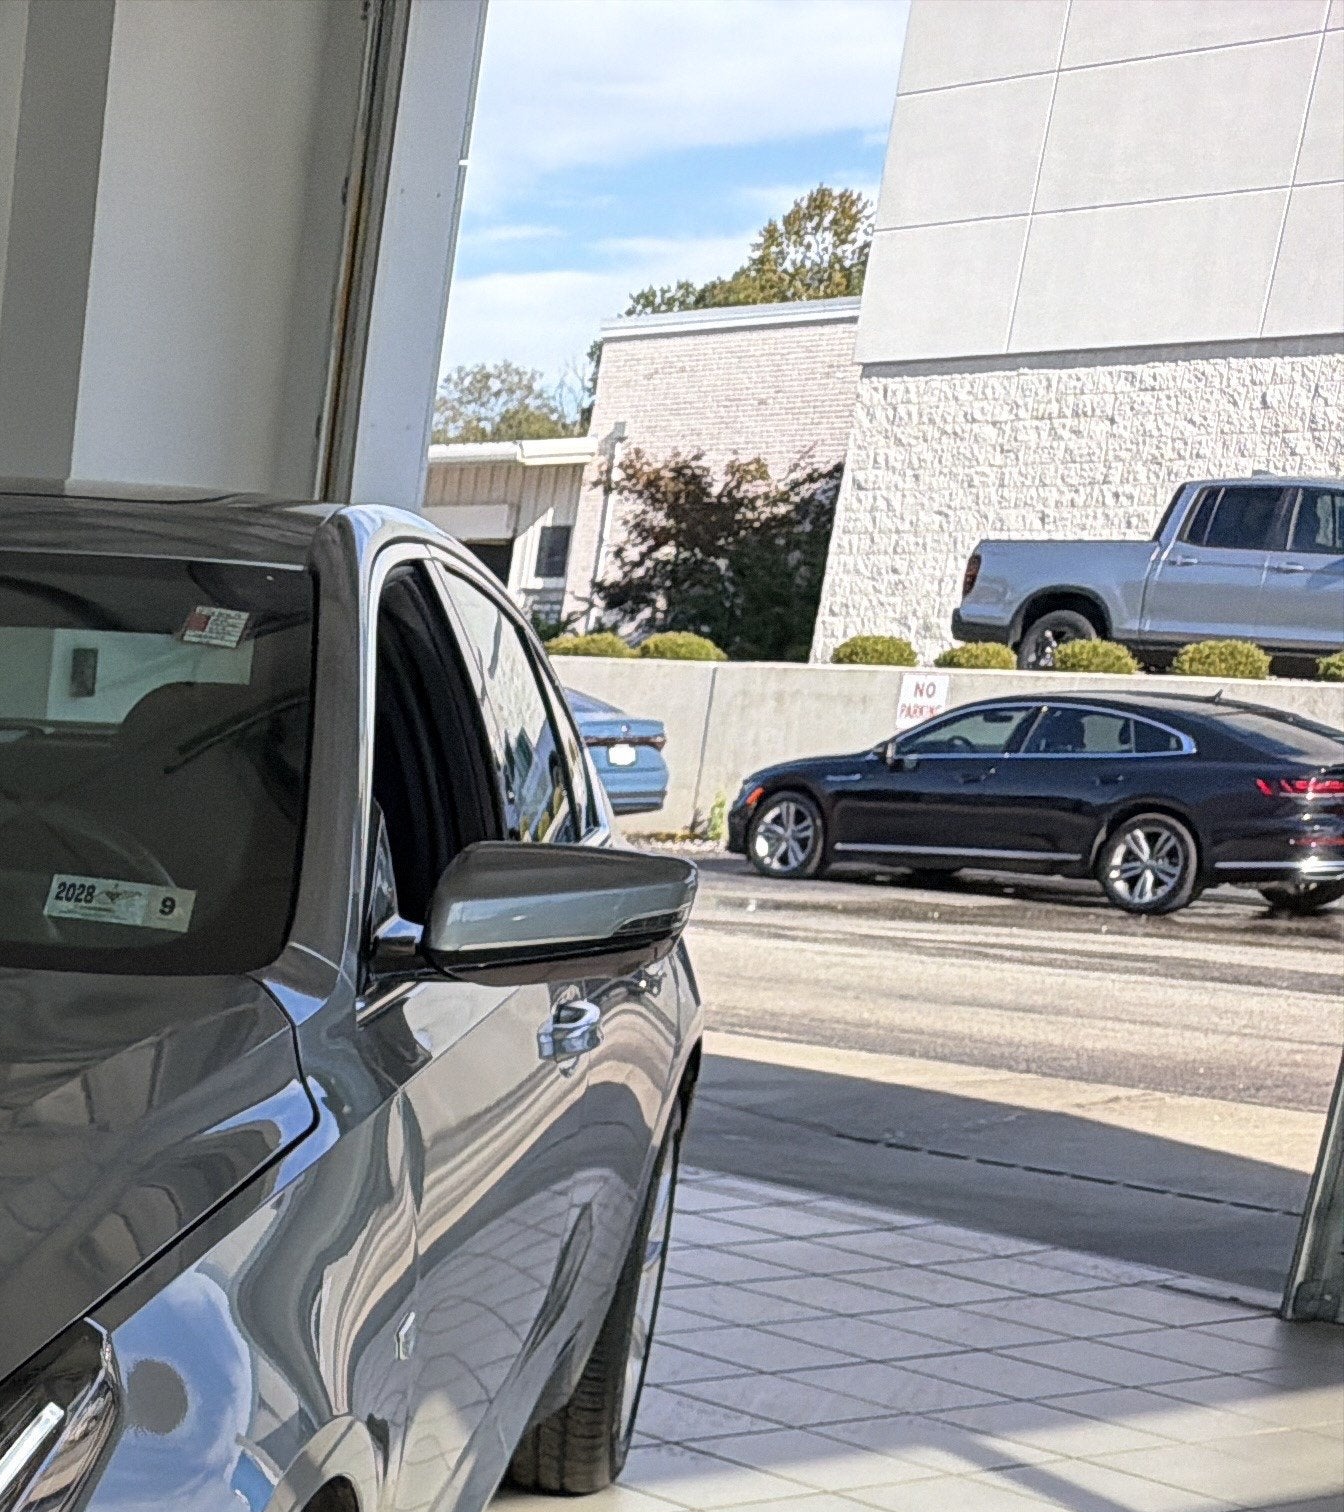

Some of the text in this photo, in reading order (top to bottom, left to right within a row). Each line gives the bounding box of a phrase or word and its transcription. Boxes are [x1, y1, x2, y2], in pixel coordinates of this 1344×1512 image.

[913, 681, 937, 699] NO
[54, 881, 177, 917] 2028 9
